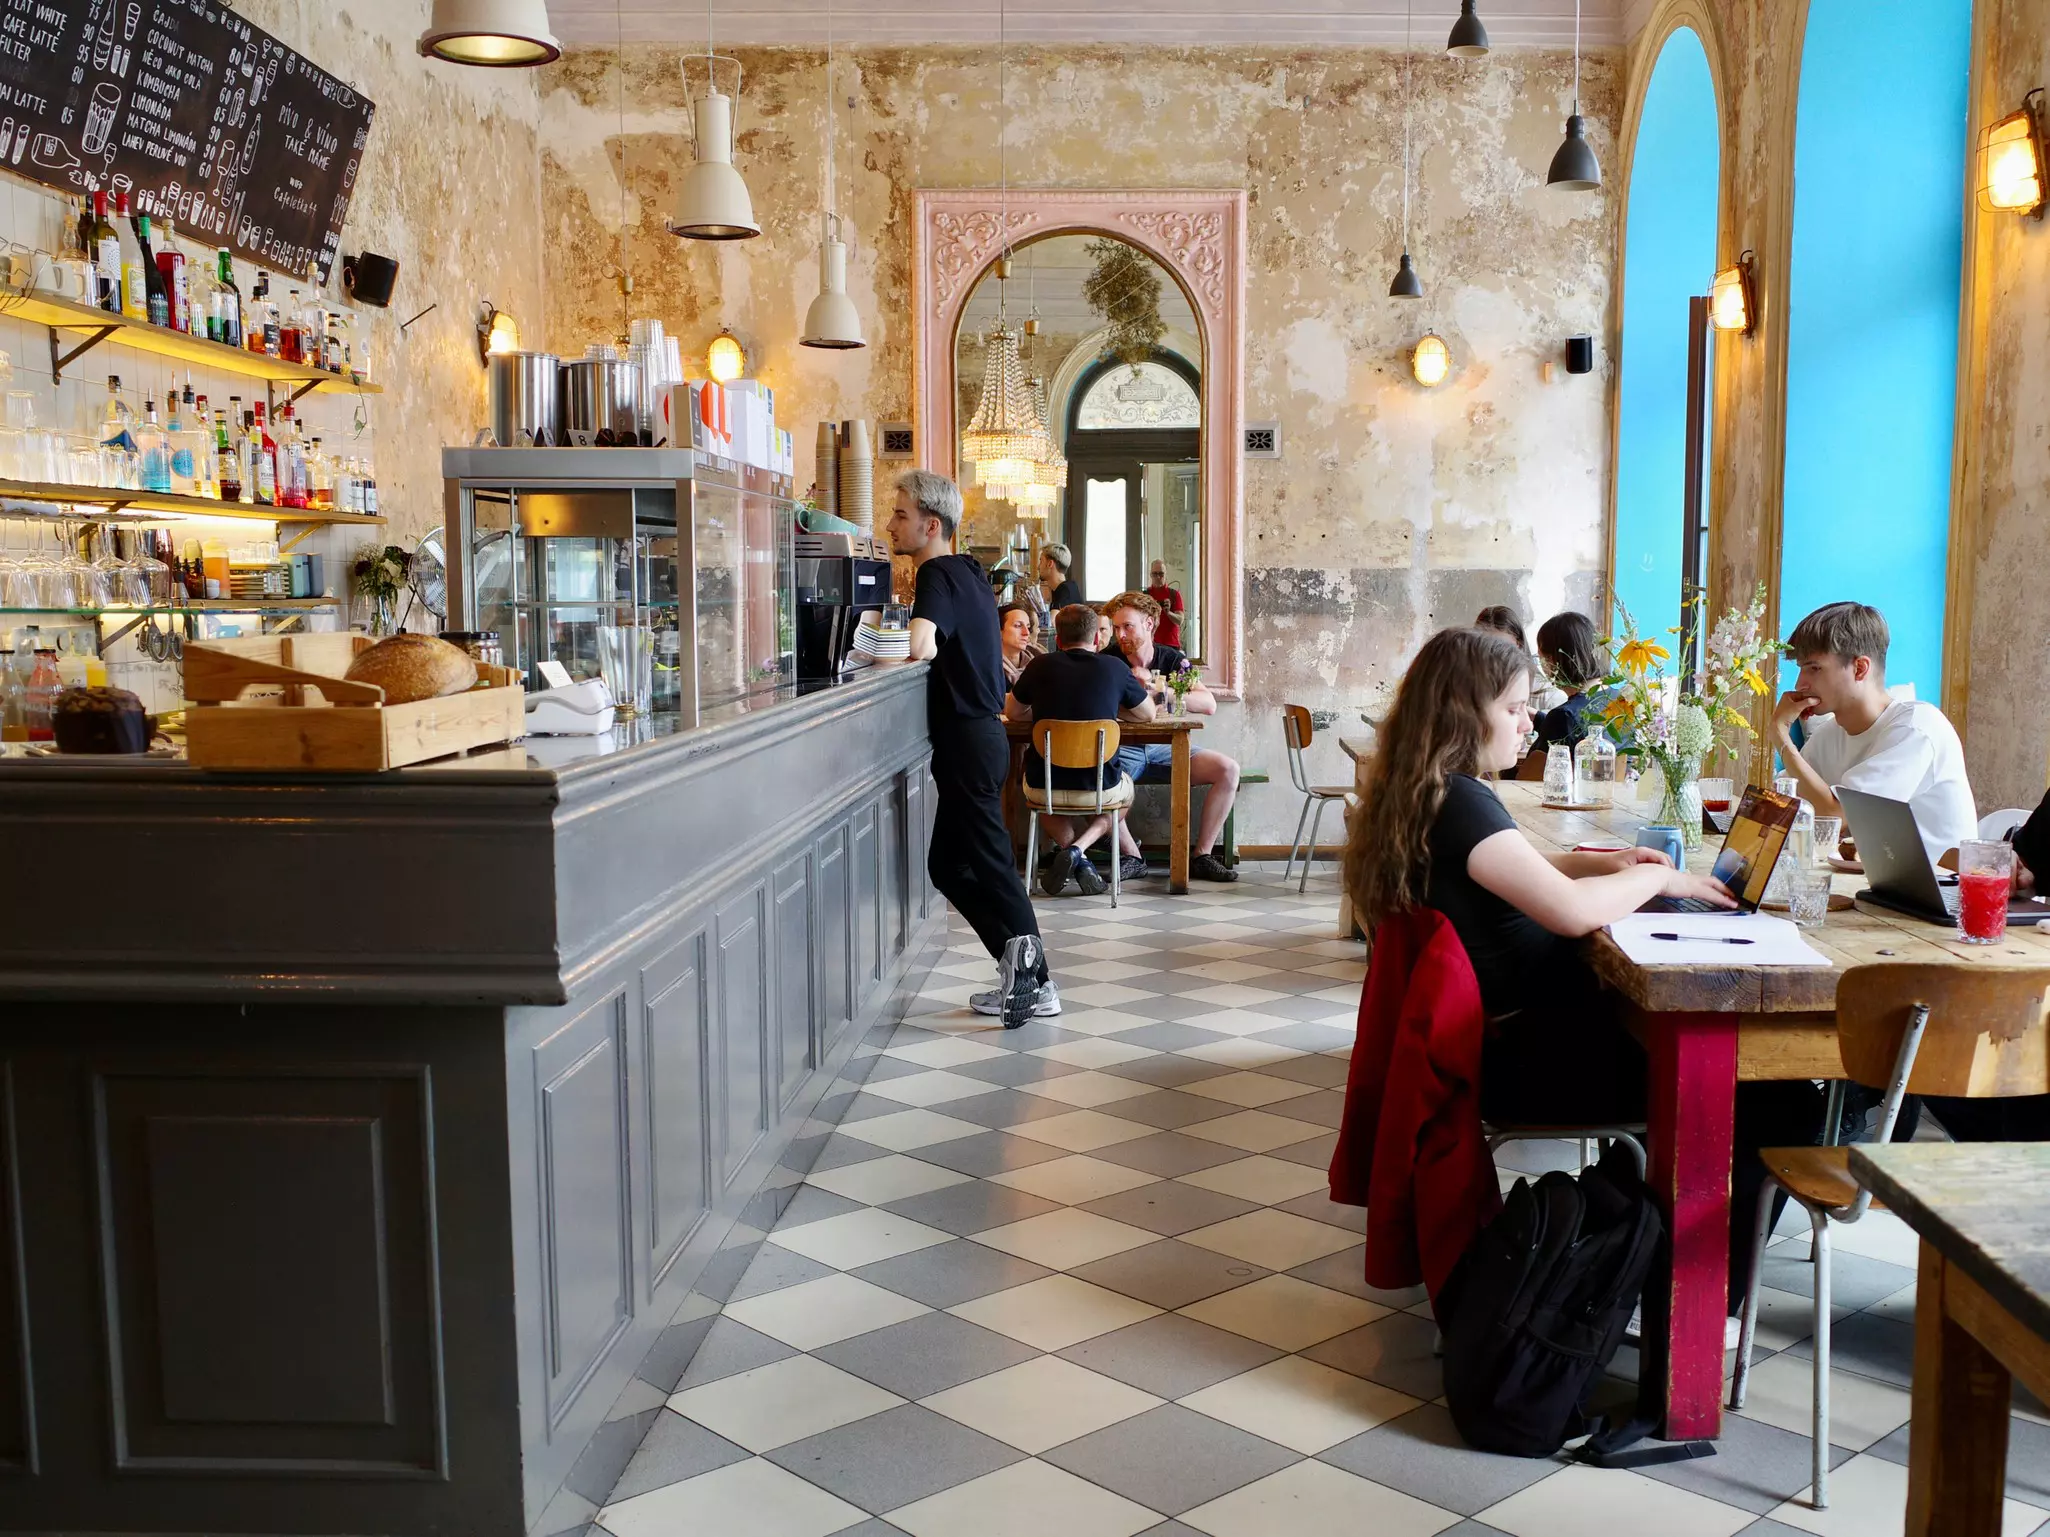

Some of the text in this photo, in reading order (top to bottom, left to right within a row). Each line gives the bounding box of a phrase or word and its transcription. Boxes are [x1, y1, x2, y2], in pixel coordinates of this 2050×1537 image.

[36, 4, 67, 31] WHITE
[82, 24, 95, 42] 90
[88, 3, 101, 20] 75
[3, 13, 27, 38] CAFE
[77, 44, 90, 63] 95
[147, 29, 237, 86] COCONUT MATCHA 95
[228, 47, 242, 66] 80
[0, 34, 84, 84] FILTER 80
[136, 69, 227, 123] KOMBUCHA 85
[165, 64, 182, 80] JAKO
[183, 73, 201, 91] COLA
[219, 86, 232, 105] 60
[14, 89, 47, 115] LATTE
[61, 106, 75, 124] 85
[131, 92, 221, 142] LIMONÁDA 90
[126, 112, 216, 161] MATCHA LIMONÁDA 90
[304, 118, 314, 140] &
[316, 122, 338, 154] VÍNO
[198, 161, 212, 179] 60
[578, 435, 587, 446] 8
